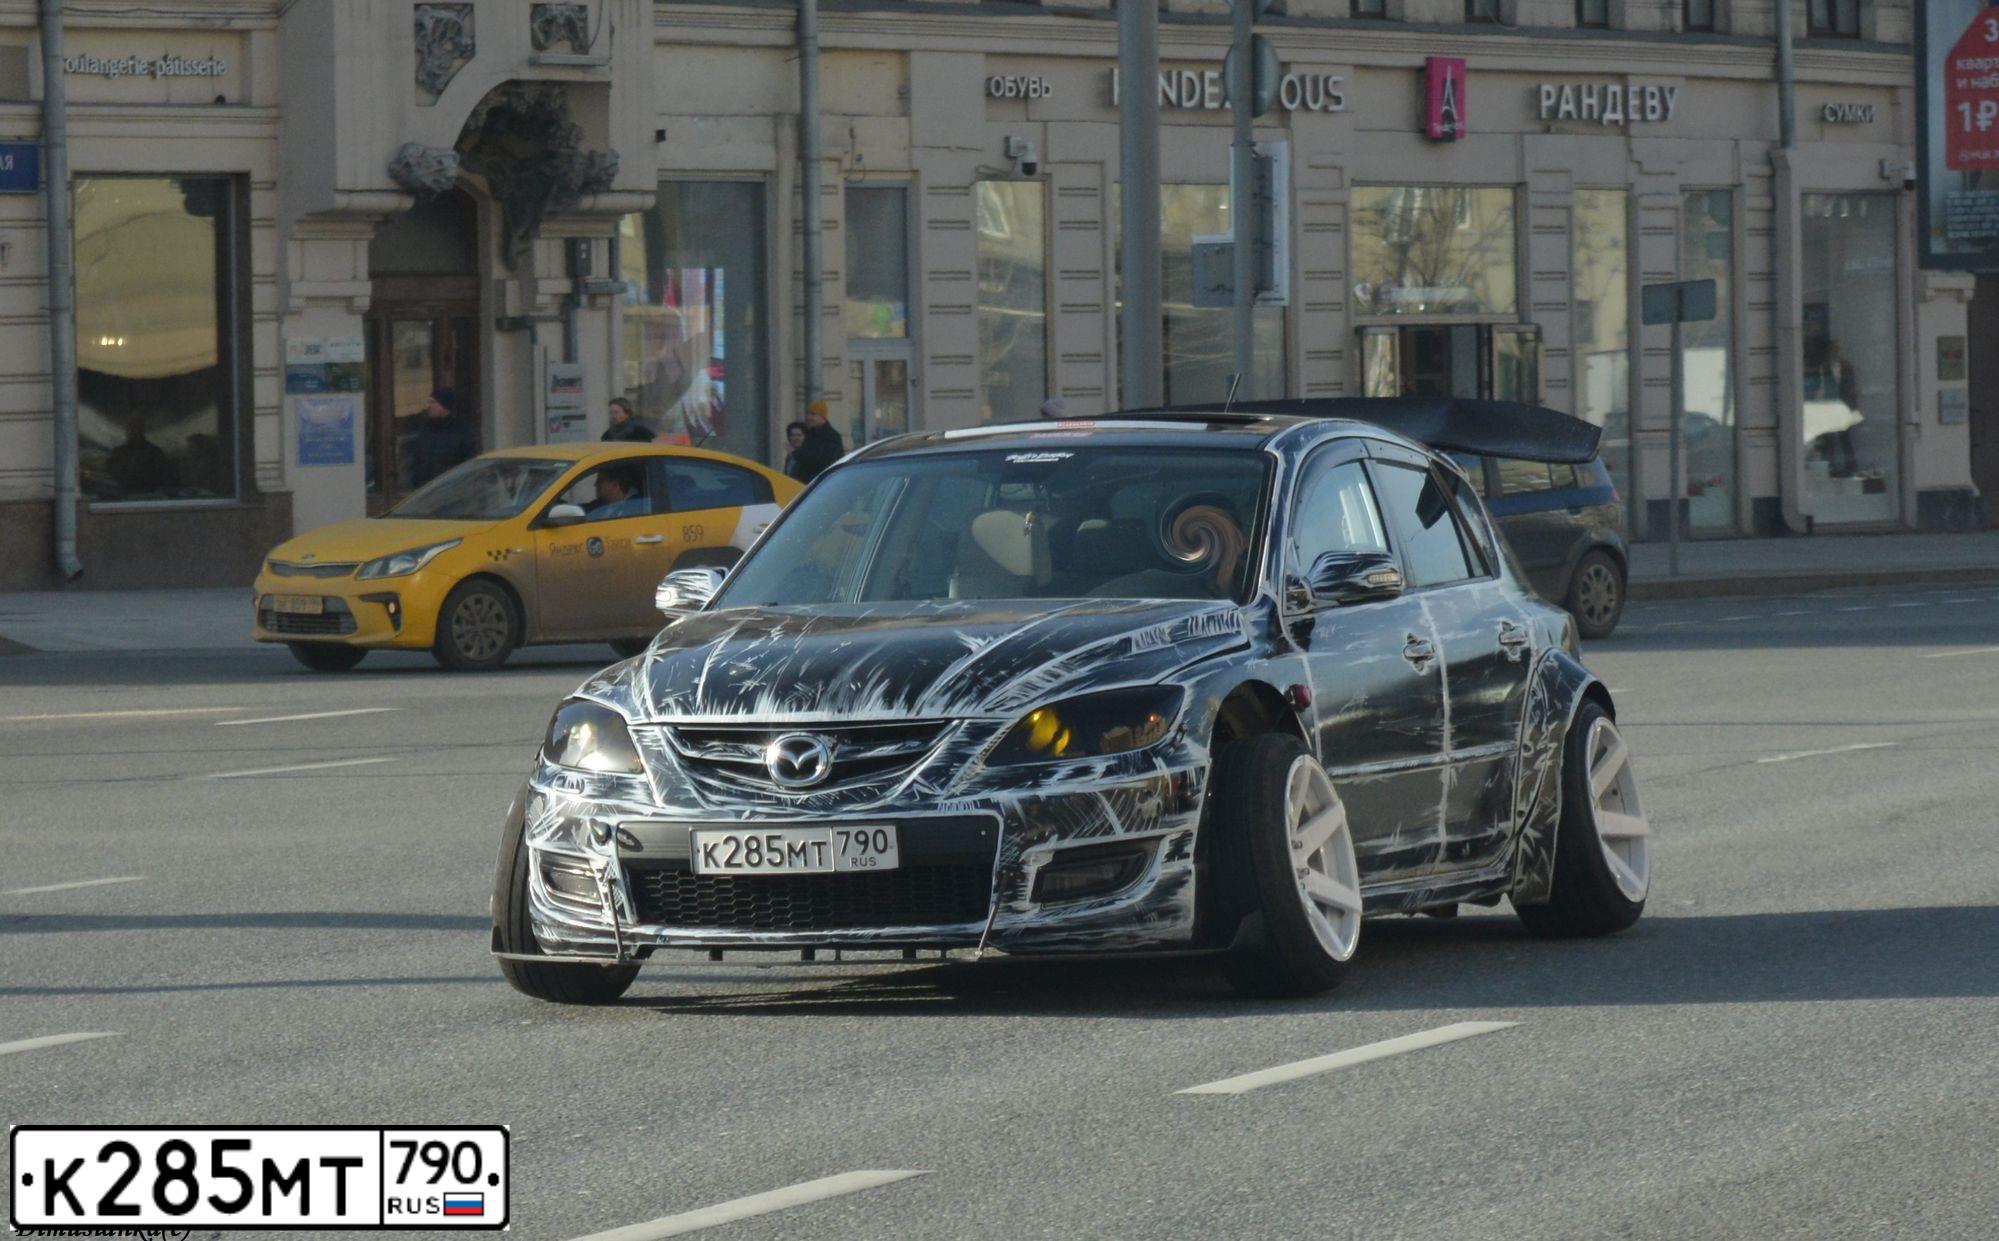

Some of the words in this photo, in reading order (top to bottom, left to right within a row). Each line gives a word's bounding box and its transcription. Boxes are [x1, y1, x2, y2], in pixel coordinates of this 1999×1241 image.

[990, 76, 1052, 99] ОБУВЬ
[1540, 83, 1679, 126] РАНДЕВУ
[1824, 104, 1876, 123] СУМКИ
[682, 524, 704, 544] 859
[702, 834, 827, 869] К285МТ
[836, 828, 889, 856] 790
[850, 856, 877, 867] RUS
